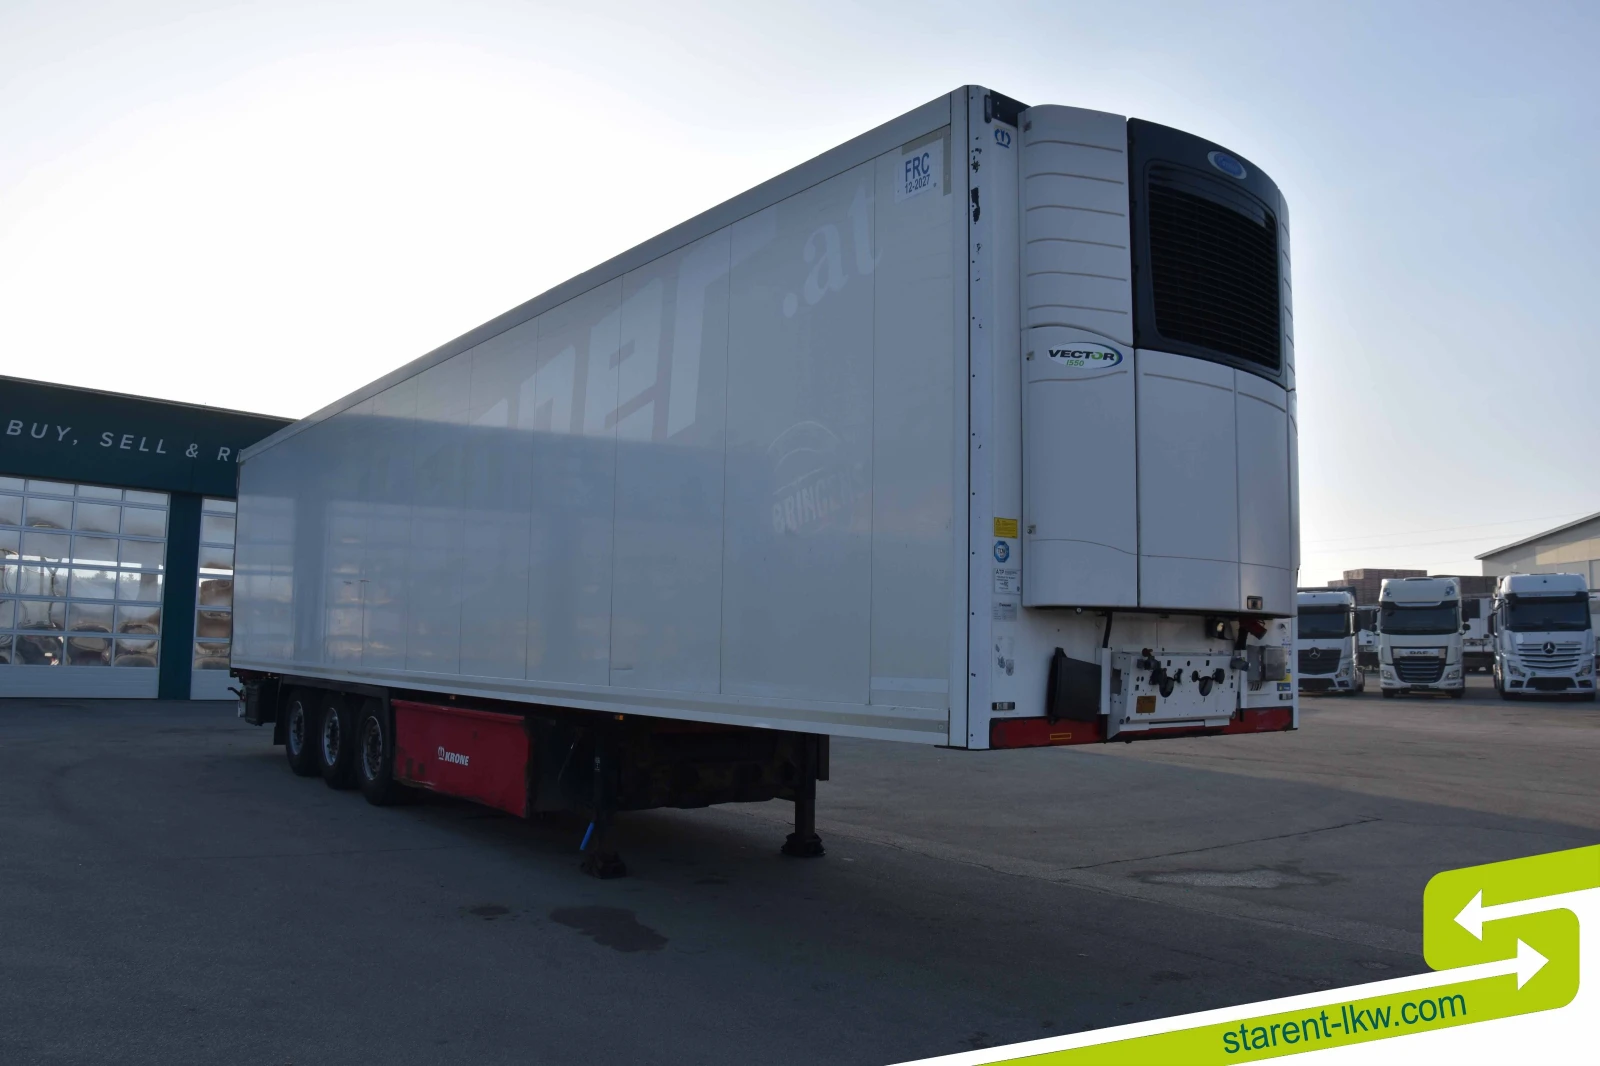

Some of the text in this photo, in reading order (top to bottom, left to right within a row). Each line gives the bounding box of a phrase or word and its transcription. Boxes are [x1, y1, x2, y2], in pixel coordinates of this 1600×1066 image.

[905, 152, 930, 182] FRC
[905, 174, 931, 194] 12-2027
[1048, 349, 1115, 361] VECTOR
[6, 419, 79, 446] BUY,
[99, 431, 167, 455] SELL
[185, 443, 199, 459] &
[445, 751, 470, 767] KRONE
